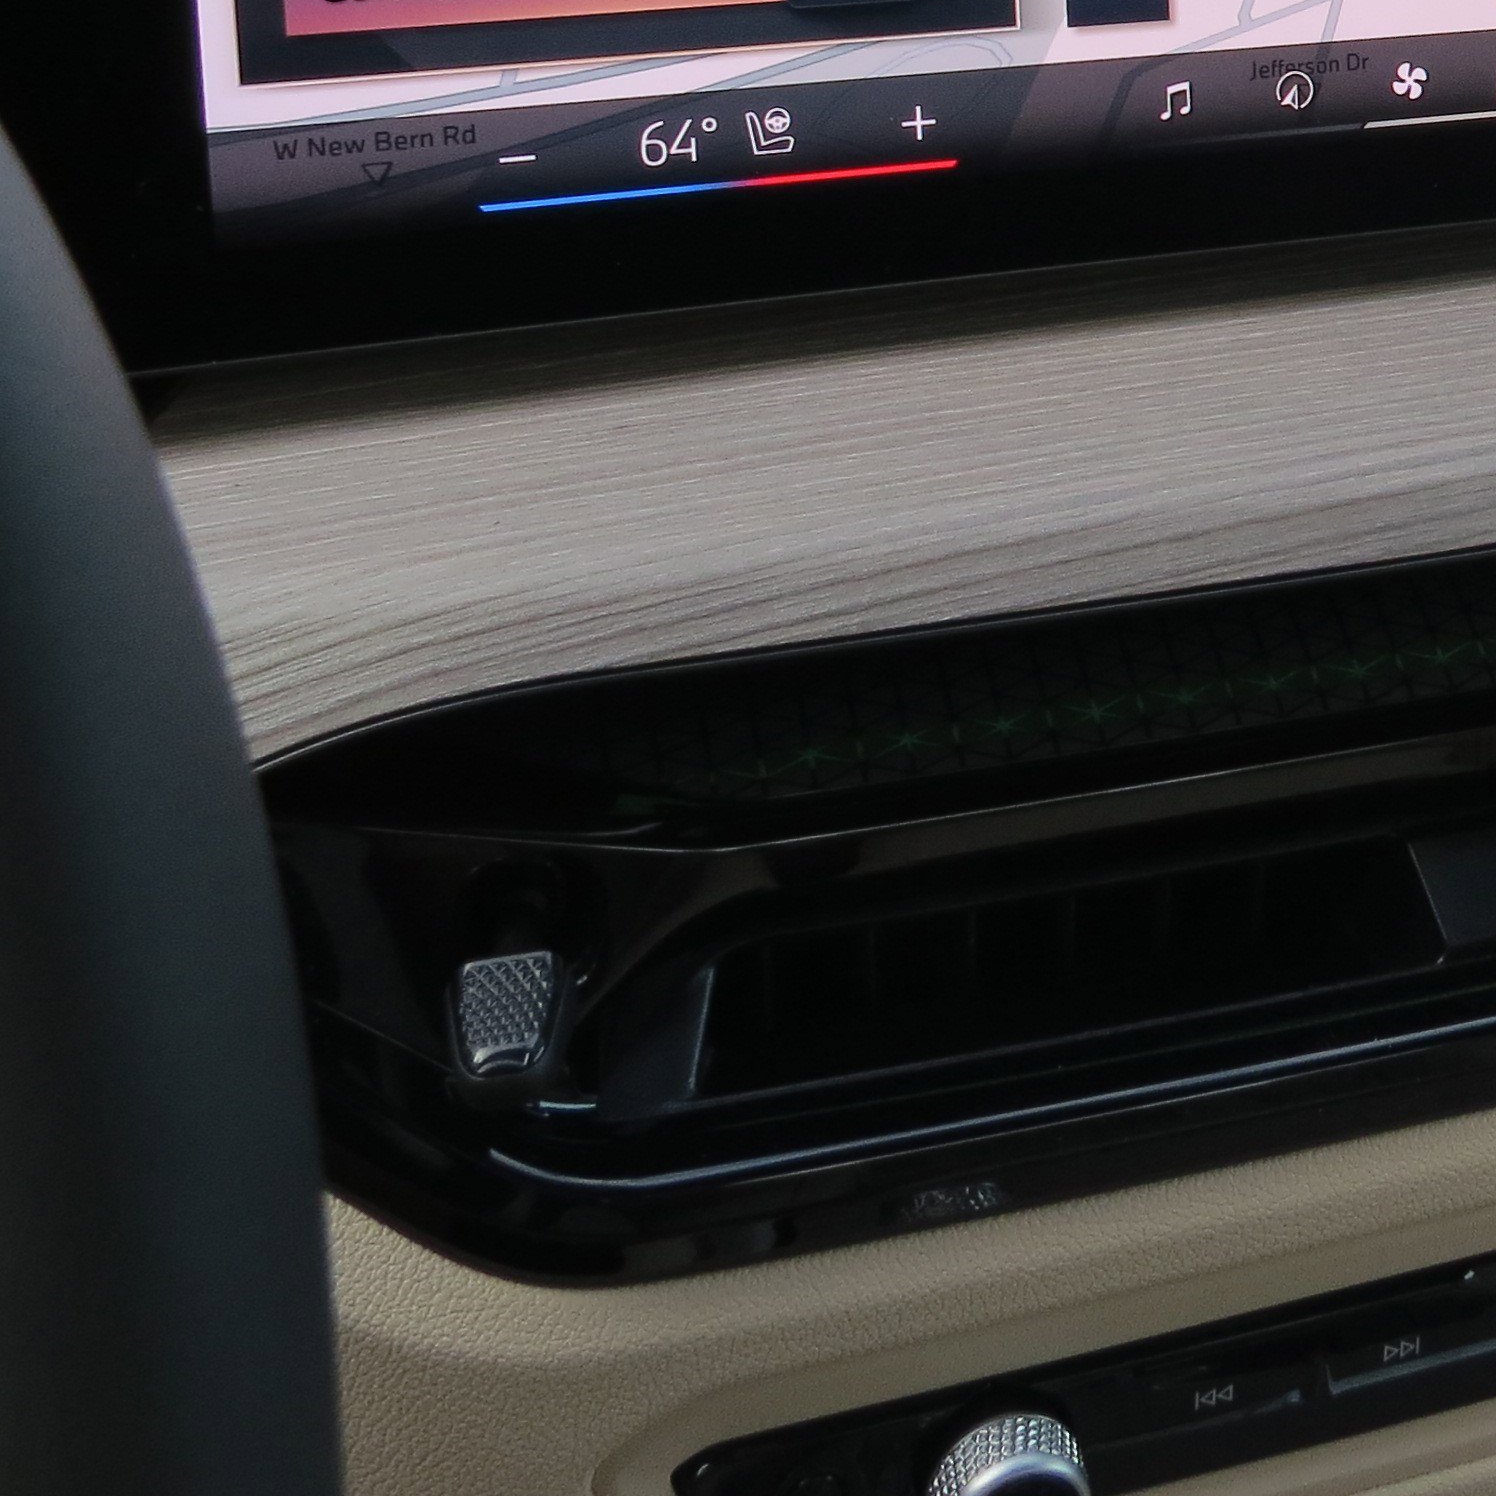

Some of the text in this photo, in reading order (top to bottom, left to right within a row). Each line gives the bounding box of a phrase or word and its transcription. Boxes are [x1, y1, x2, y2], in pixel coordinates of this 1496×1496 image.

[1250, 54, 1370, 81] Jefferson Dr
[272, 123, 477, 161] W New Bern Rd
[639, 115, 719, 167] 64°
